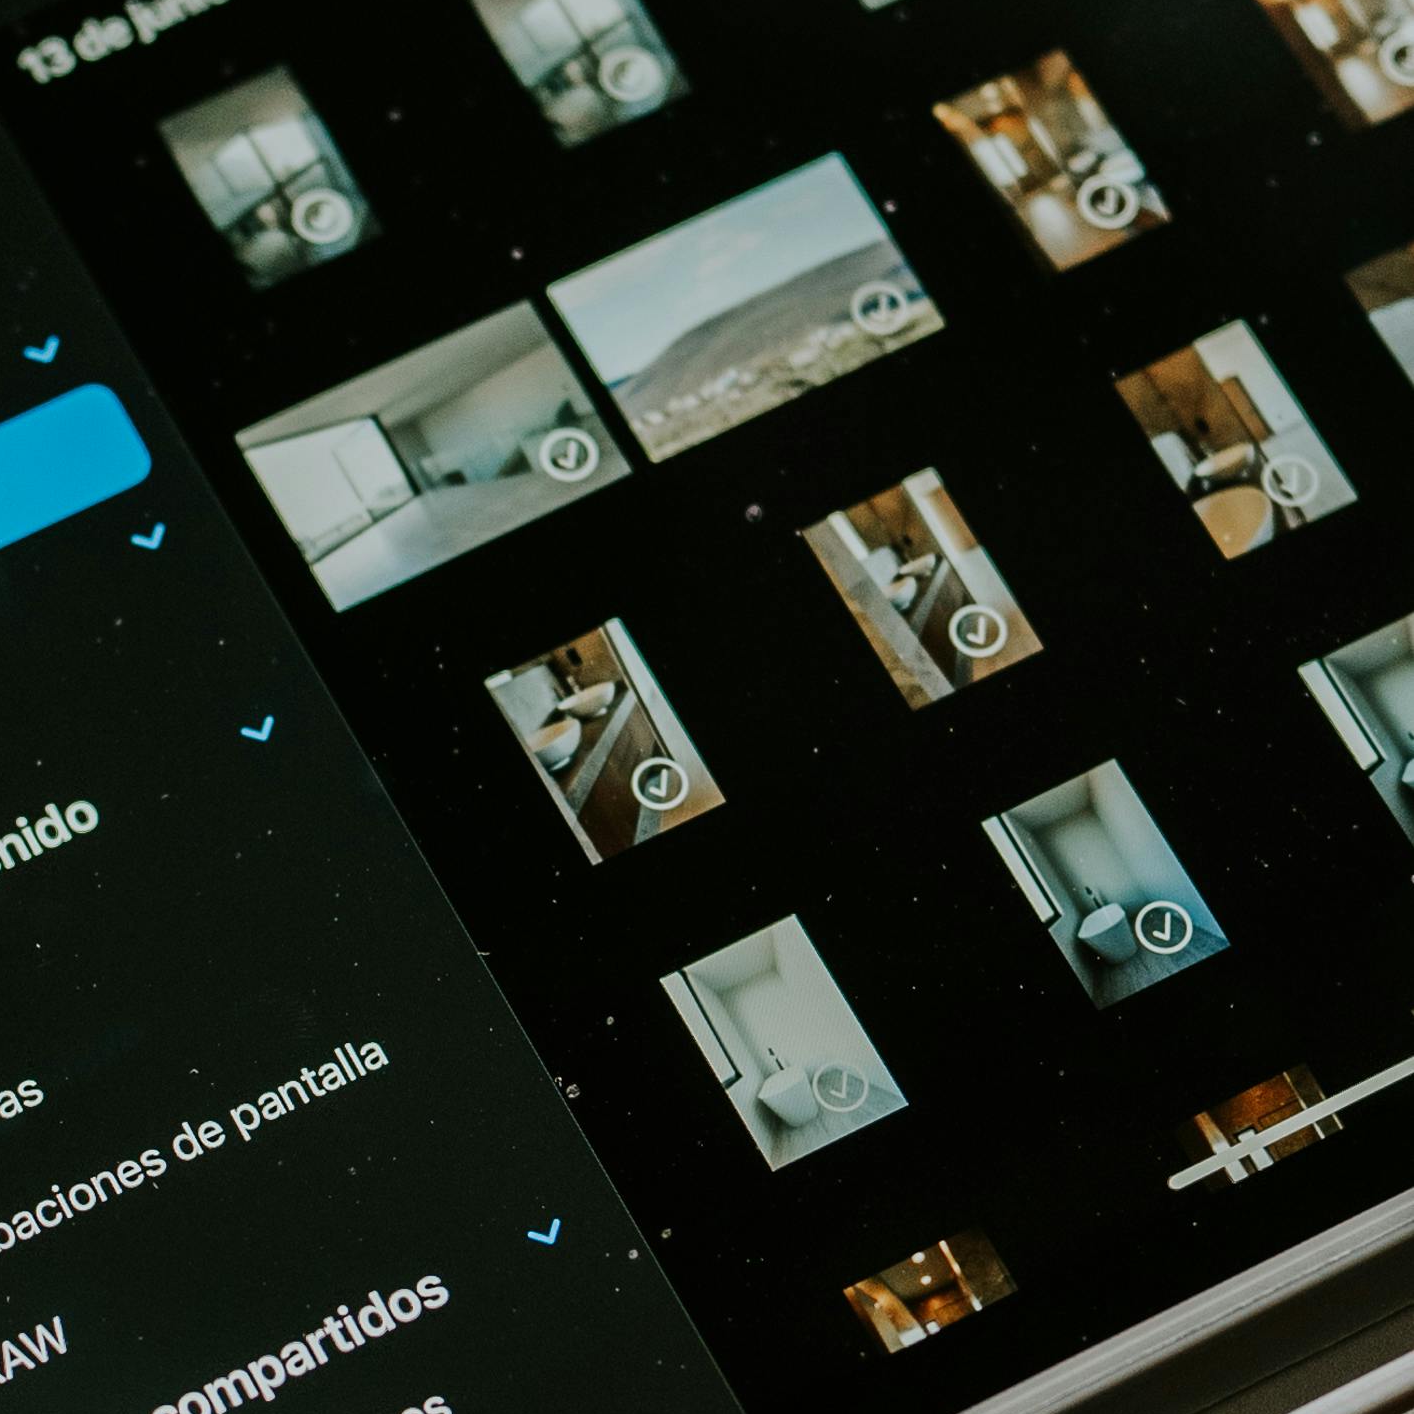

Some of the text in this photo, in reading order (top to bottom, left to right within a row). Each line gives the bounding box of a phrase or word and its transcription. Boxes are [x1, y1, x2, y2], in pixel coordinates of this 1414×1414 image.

[18, 37, 76, 83] 13
[73, 16, 134, 61] de
[172, 1120, 226, 1162] de
[229, 1039, 390, 1142] pantalla
